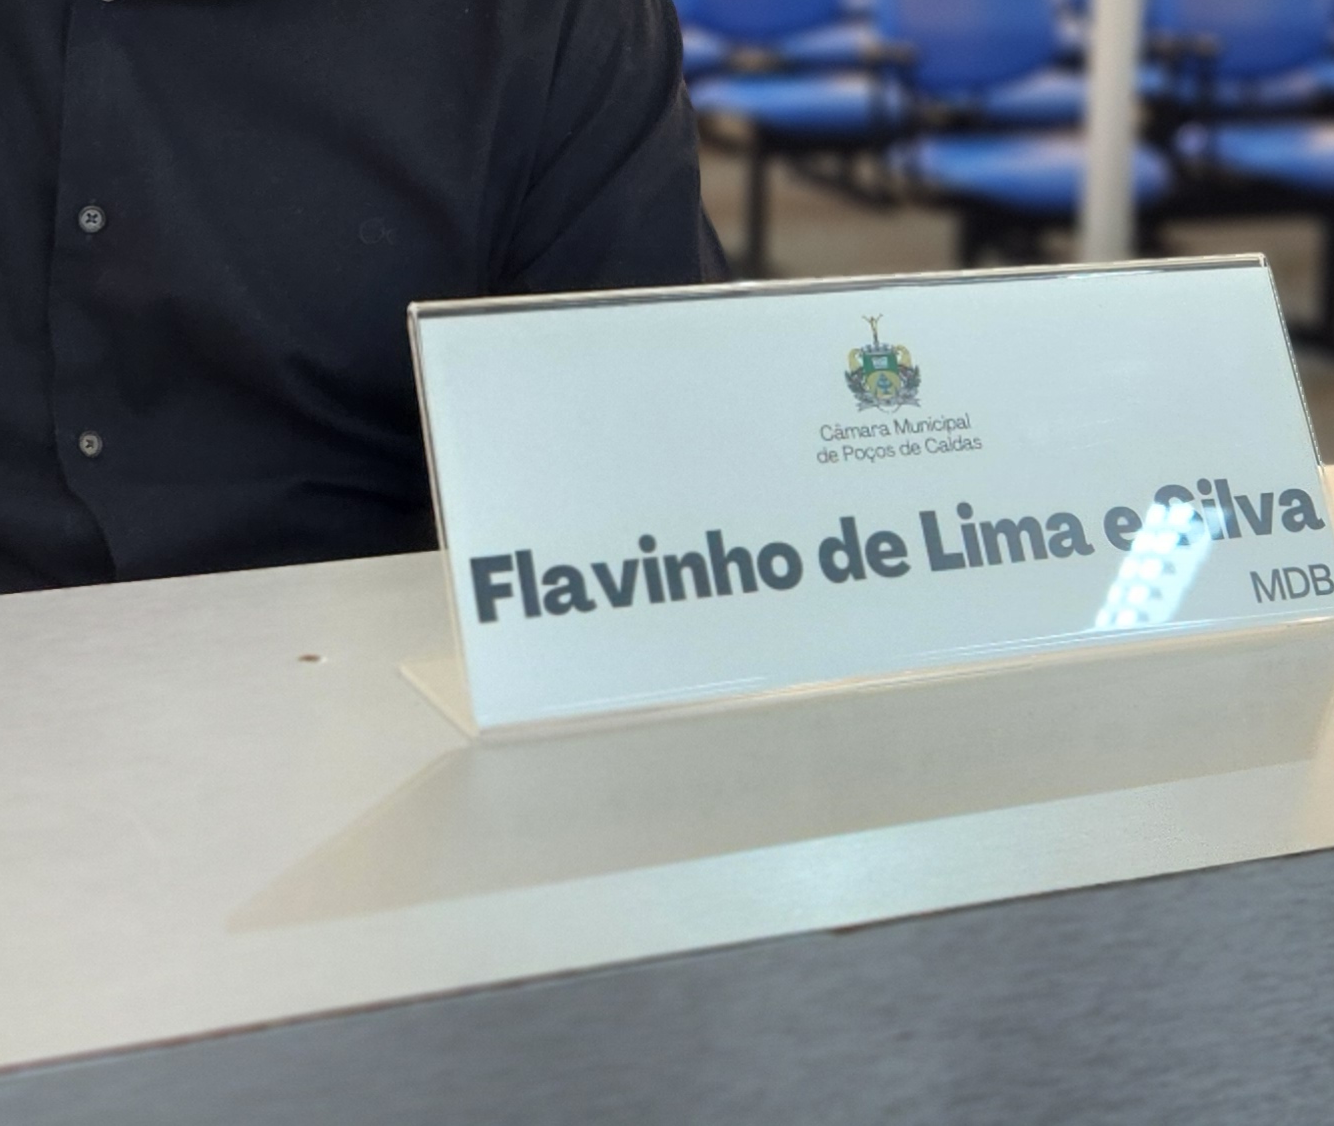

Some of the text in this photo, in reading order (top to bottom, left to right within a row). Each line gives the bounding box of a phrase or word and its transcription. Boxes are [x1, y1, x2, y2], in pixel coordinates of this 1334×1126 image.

[820, 412, 972, 442] Câmara Municipal
[817, 435, 983, 464] de Poços de Caldas
[470, 529, 803, 624] Flavinho
[818, 516, 911, 584] de
[919, 502, 1095, 571] Lima
[1103, 506, 1143, 552] e
